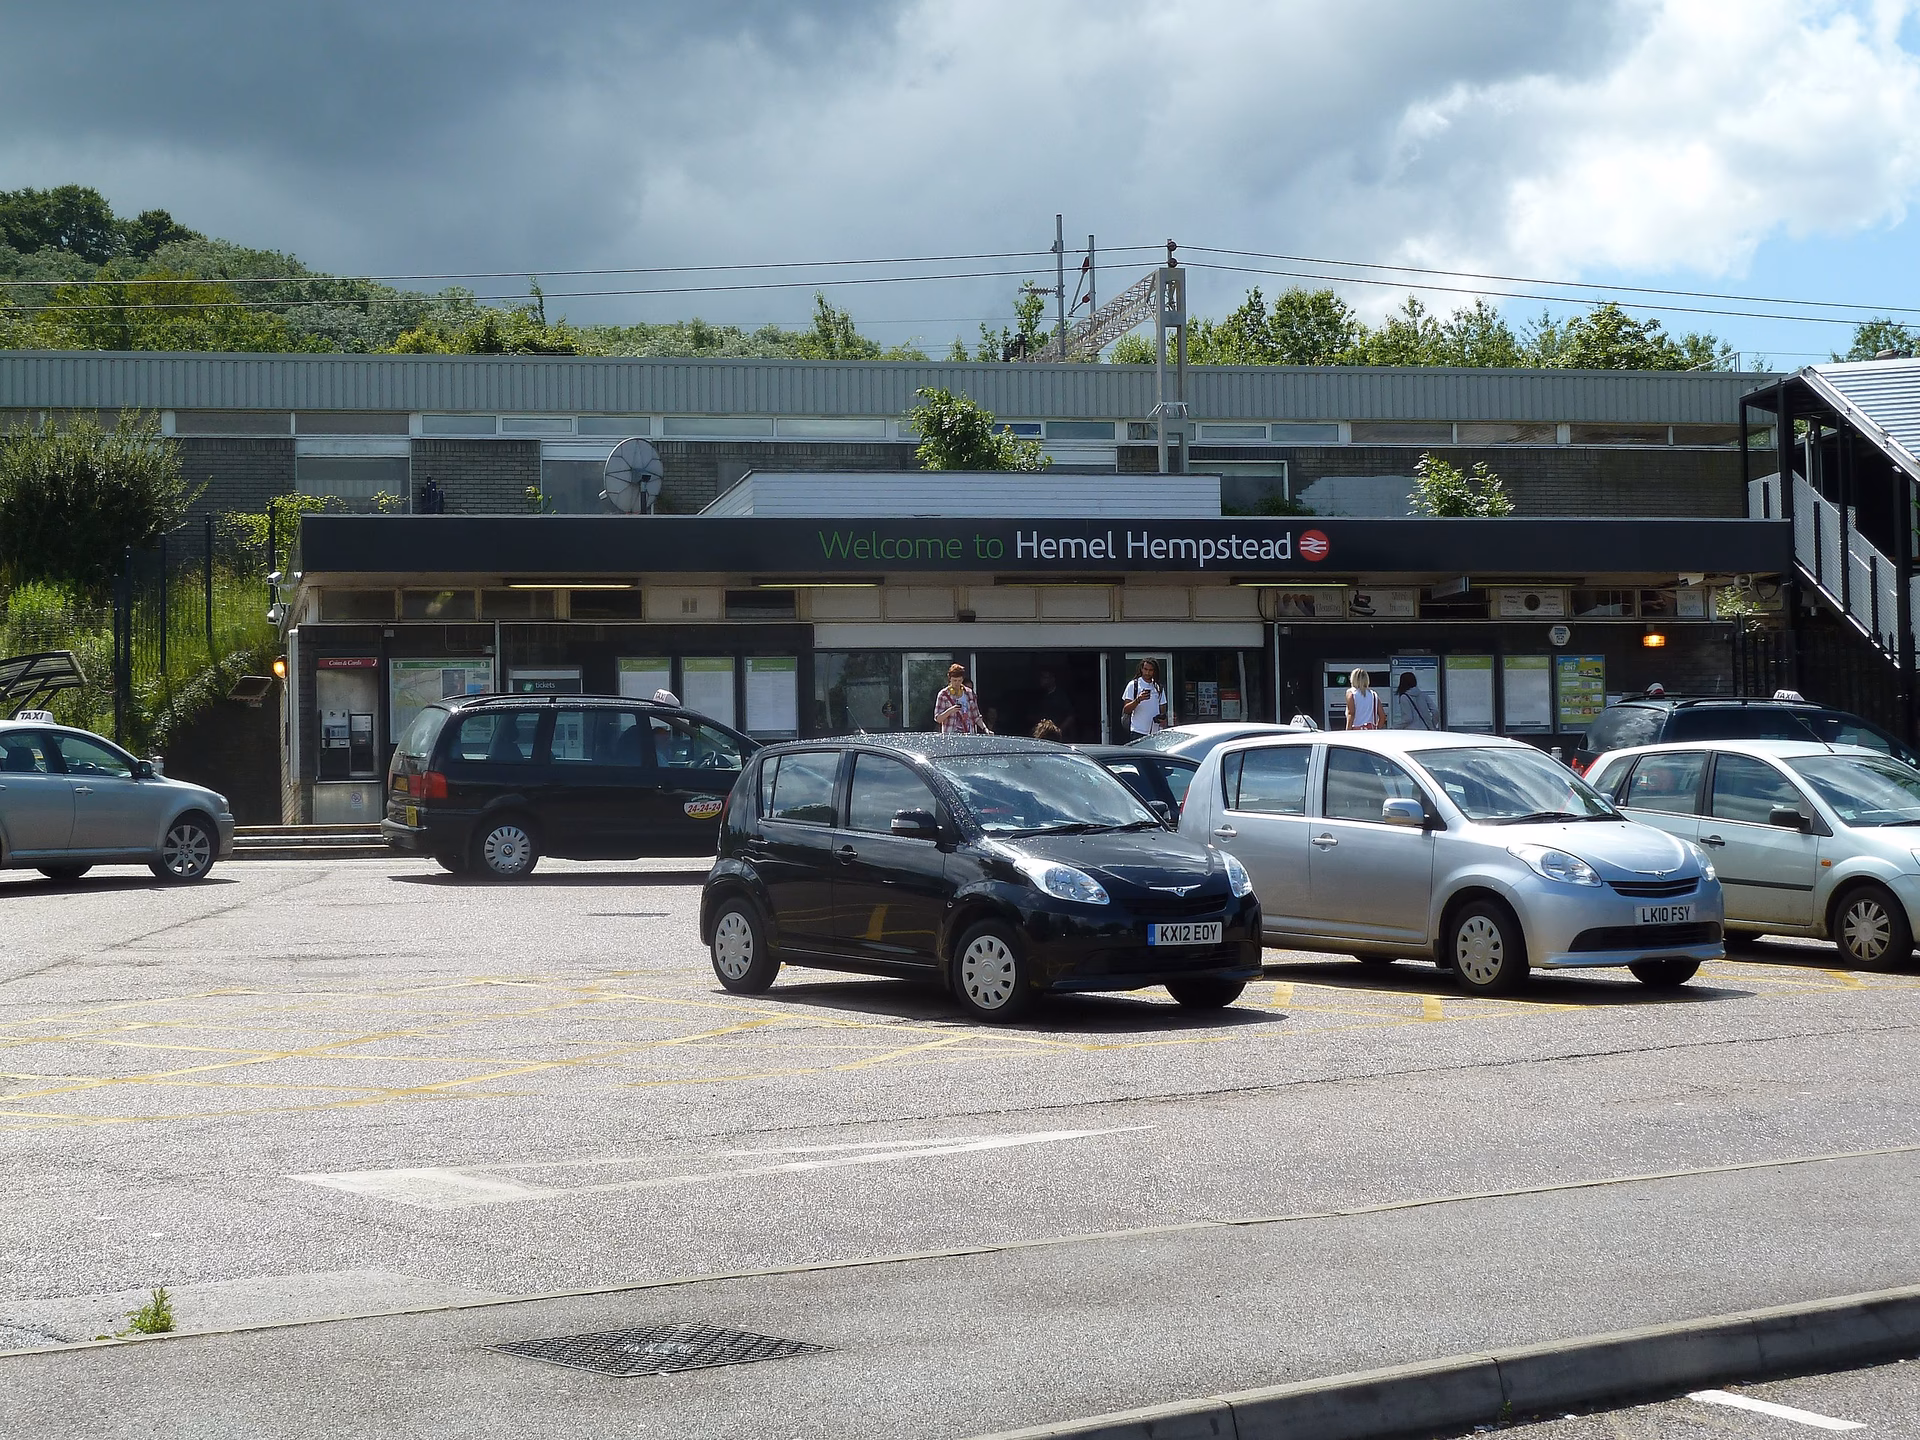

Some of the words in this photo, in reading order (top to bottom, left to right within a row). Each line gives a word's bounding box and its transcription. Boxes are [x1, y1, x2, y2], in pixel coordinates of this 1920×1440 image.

[819, 531, 963, 559] Welcome
[972, 534, 1004, 559] to
[1015, 530, 1117, 559] Hemel
[1127, 530, 1292, 568] Hempstead
[328, 659, 343, 667] Coins
[347, 659, 363, 667] Cards
[535, 681, 556, 689] tickets
[1775, 690, 1795, 700] TAXI
[20, 712, 45, 720] TAXI
[687, 802, 722, 813] 24-24-24
[1642, 906, 1669, 923] LK10
[1671, 905, 1691, 922] FSY
[1160, 925, 1191, 942] KX12
[1194, 924, 1218, 941] EOY
